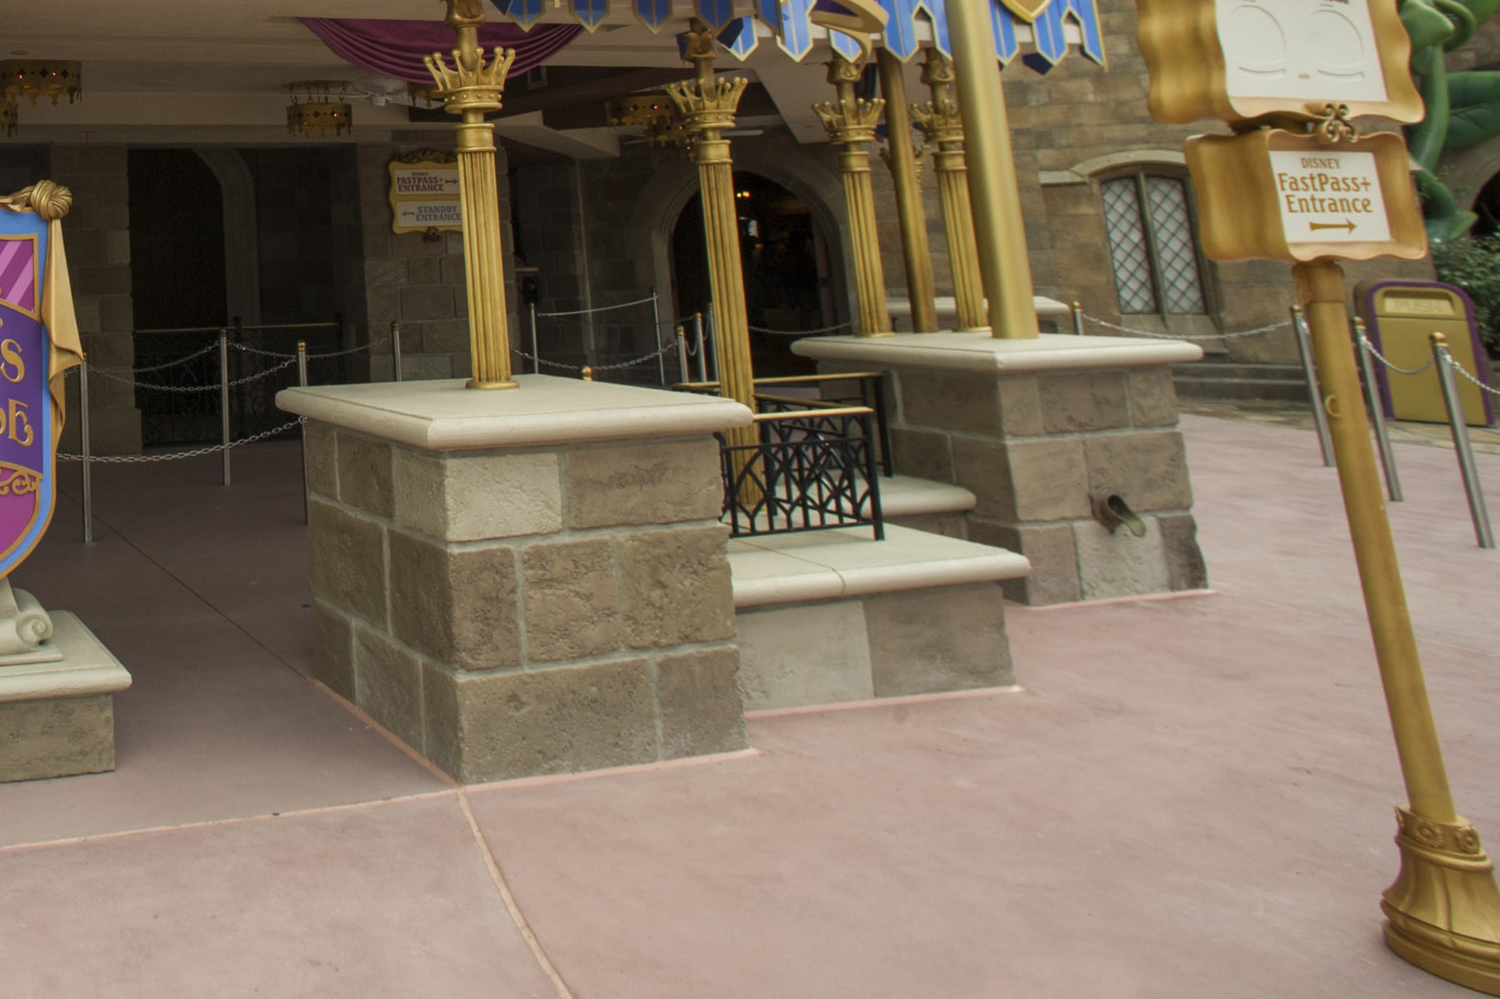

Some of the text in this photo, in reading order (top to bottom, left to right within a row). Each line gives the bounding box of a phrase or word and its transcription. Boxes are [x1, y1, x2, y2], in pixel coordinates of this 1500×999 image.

[1300, 157, 1340, 169] DISNEY
[398, 184, 444, 192] ENTRANCE
[1277, 173, 1371, 192] FastPass+
[1285, 194, 1373, 213] Entrance
